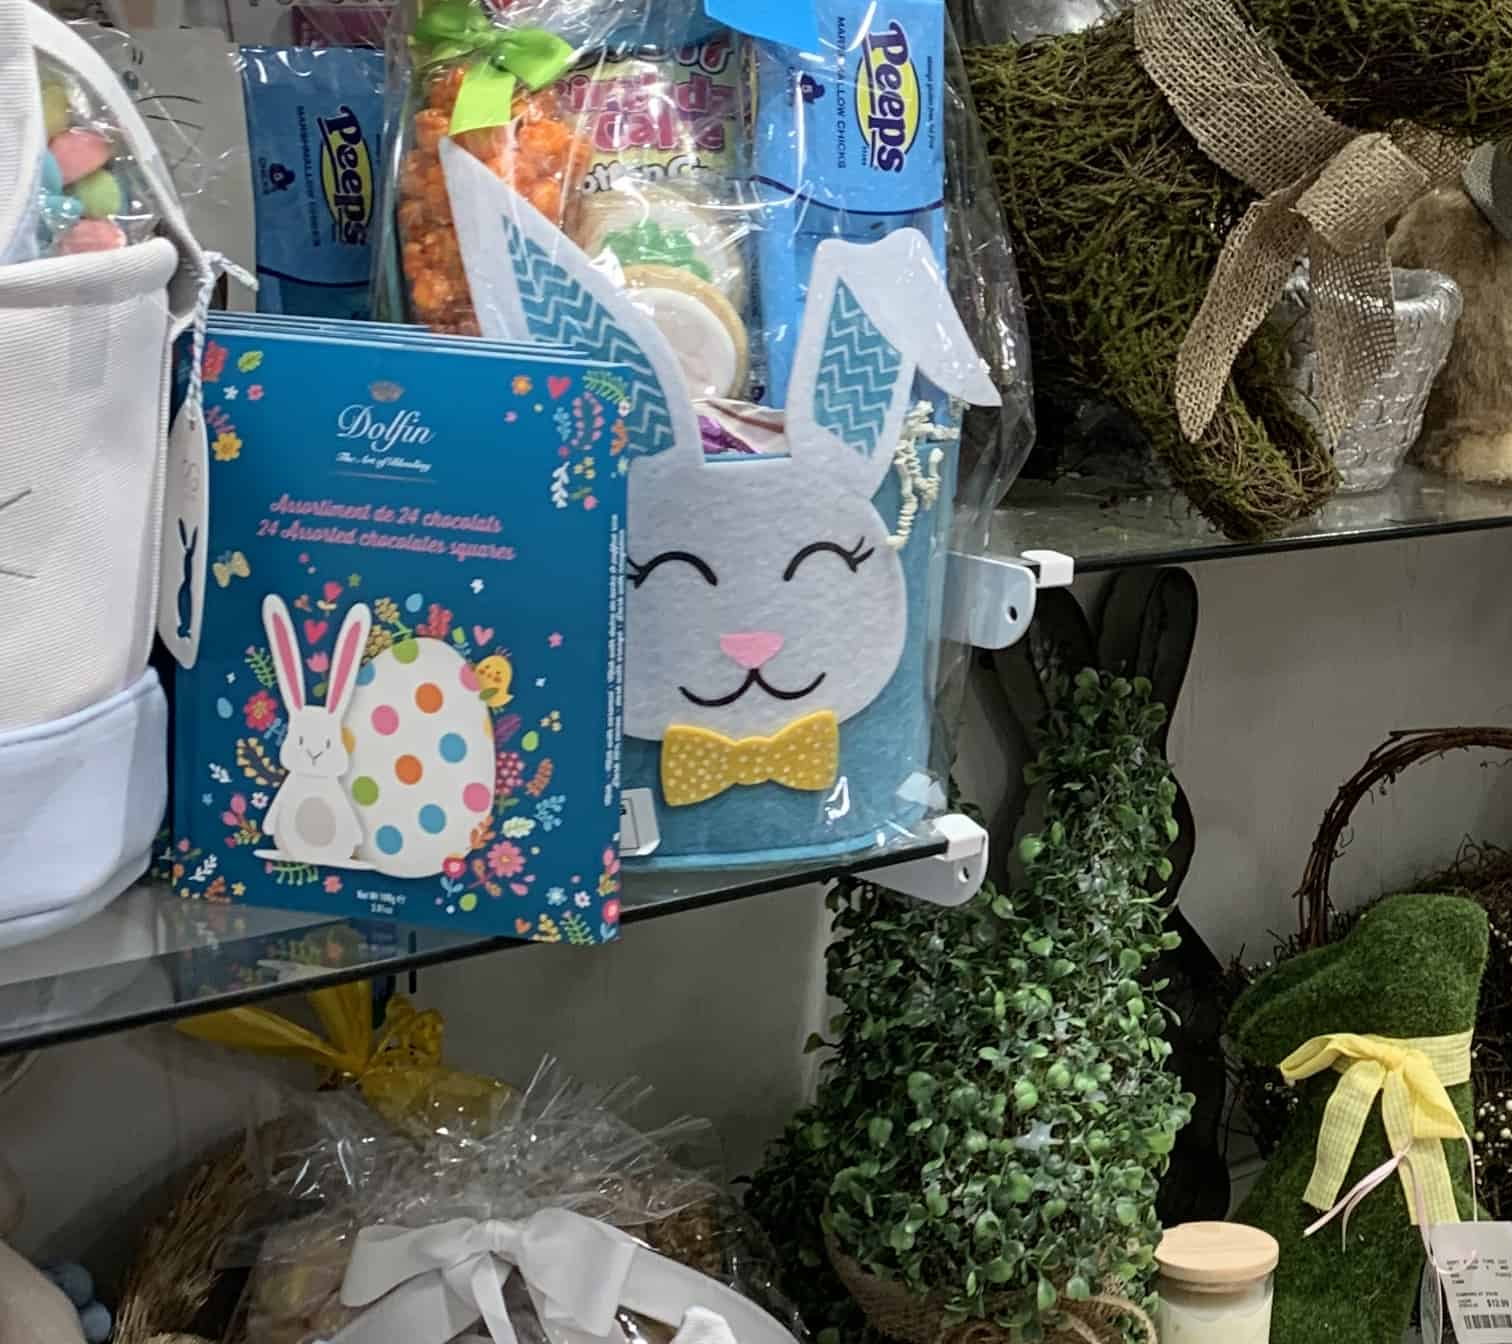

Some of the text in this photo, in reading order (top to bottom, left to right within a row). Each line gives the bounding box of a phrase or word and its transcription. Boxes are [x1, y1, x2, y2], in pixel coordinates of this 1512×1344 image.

[864, 20, 909, 174] Peeps
[837, 120, 847, 169] CHICKS
[323, 104, 369, 246] Peeps
[336, 404, 435, 452] Dolfin
[270, 493, 502, 533] Assortiment de 24 chocolats
[256, 519, 517, 562] 24 Assorted chocolates squares
